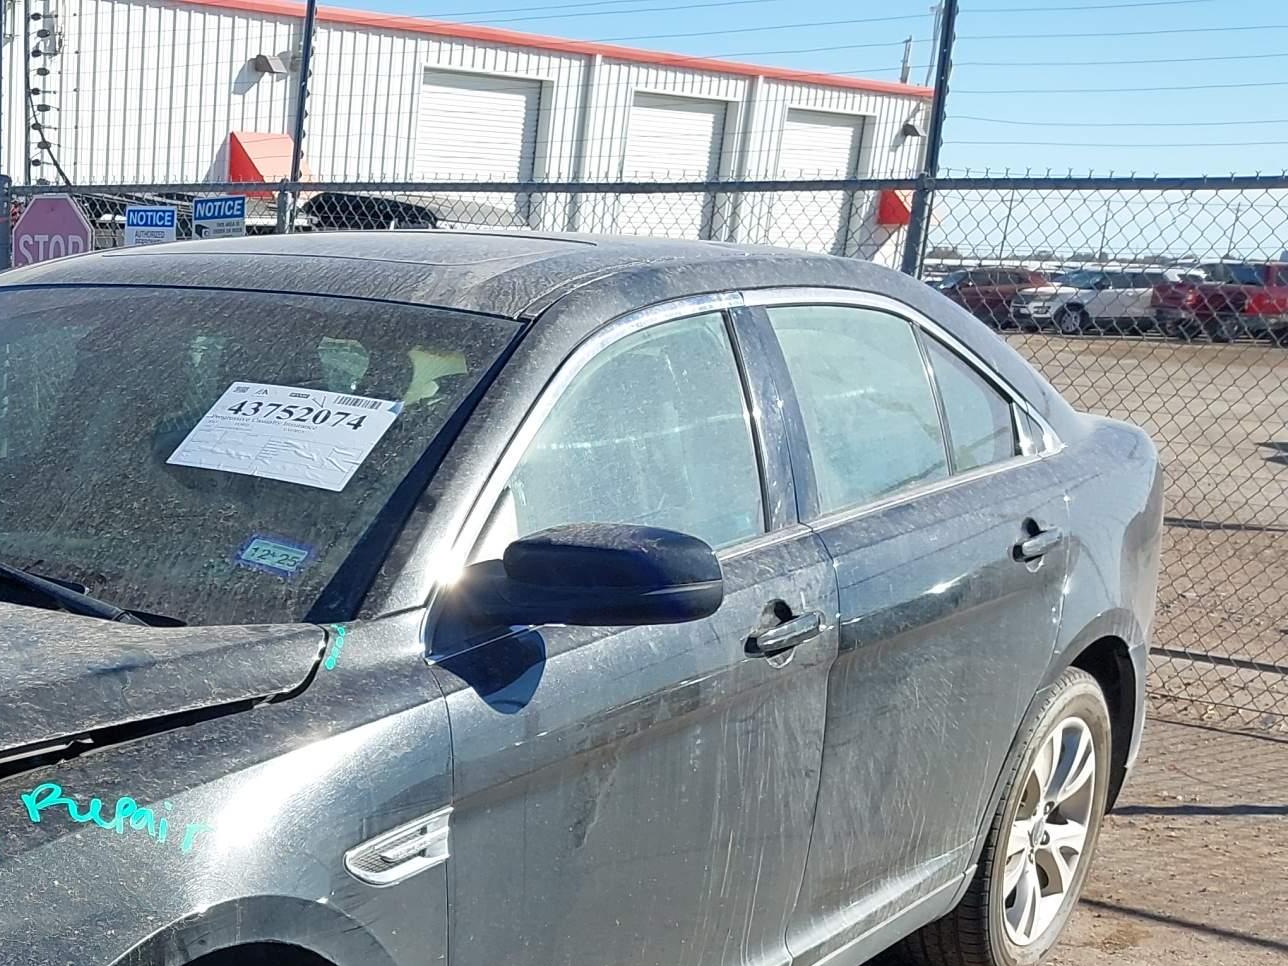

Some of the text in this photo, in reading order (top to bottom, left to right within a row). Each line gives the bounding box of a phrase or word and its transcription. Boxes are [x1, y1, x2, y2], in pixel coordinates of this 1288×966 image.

[195, 200, 243, 218] NOTICE
[129, 211, 172, 226] NOTICE
[227, 400, 368, 431] 43752074
